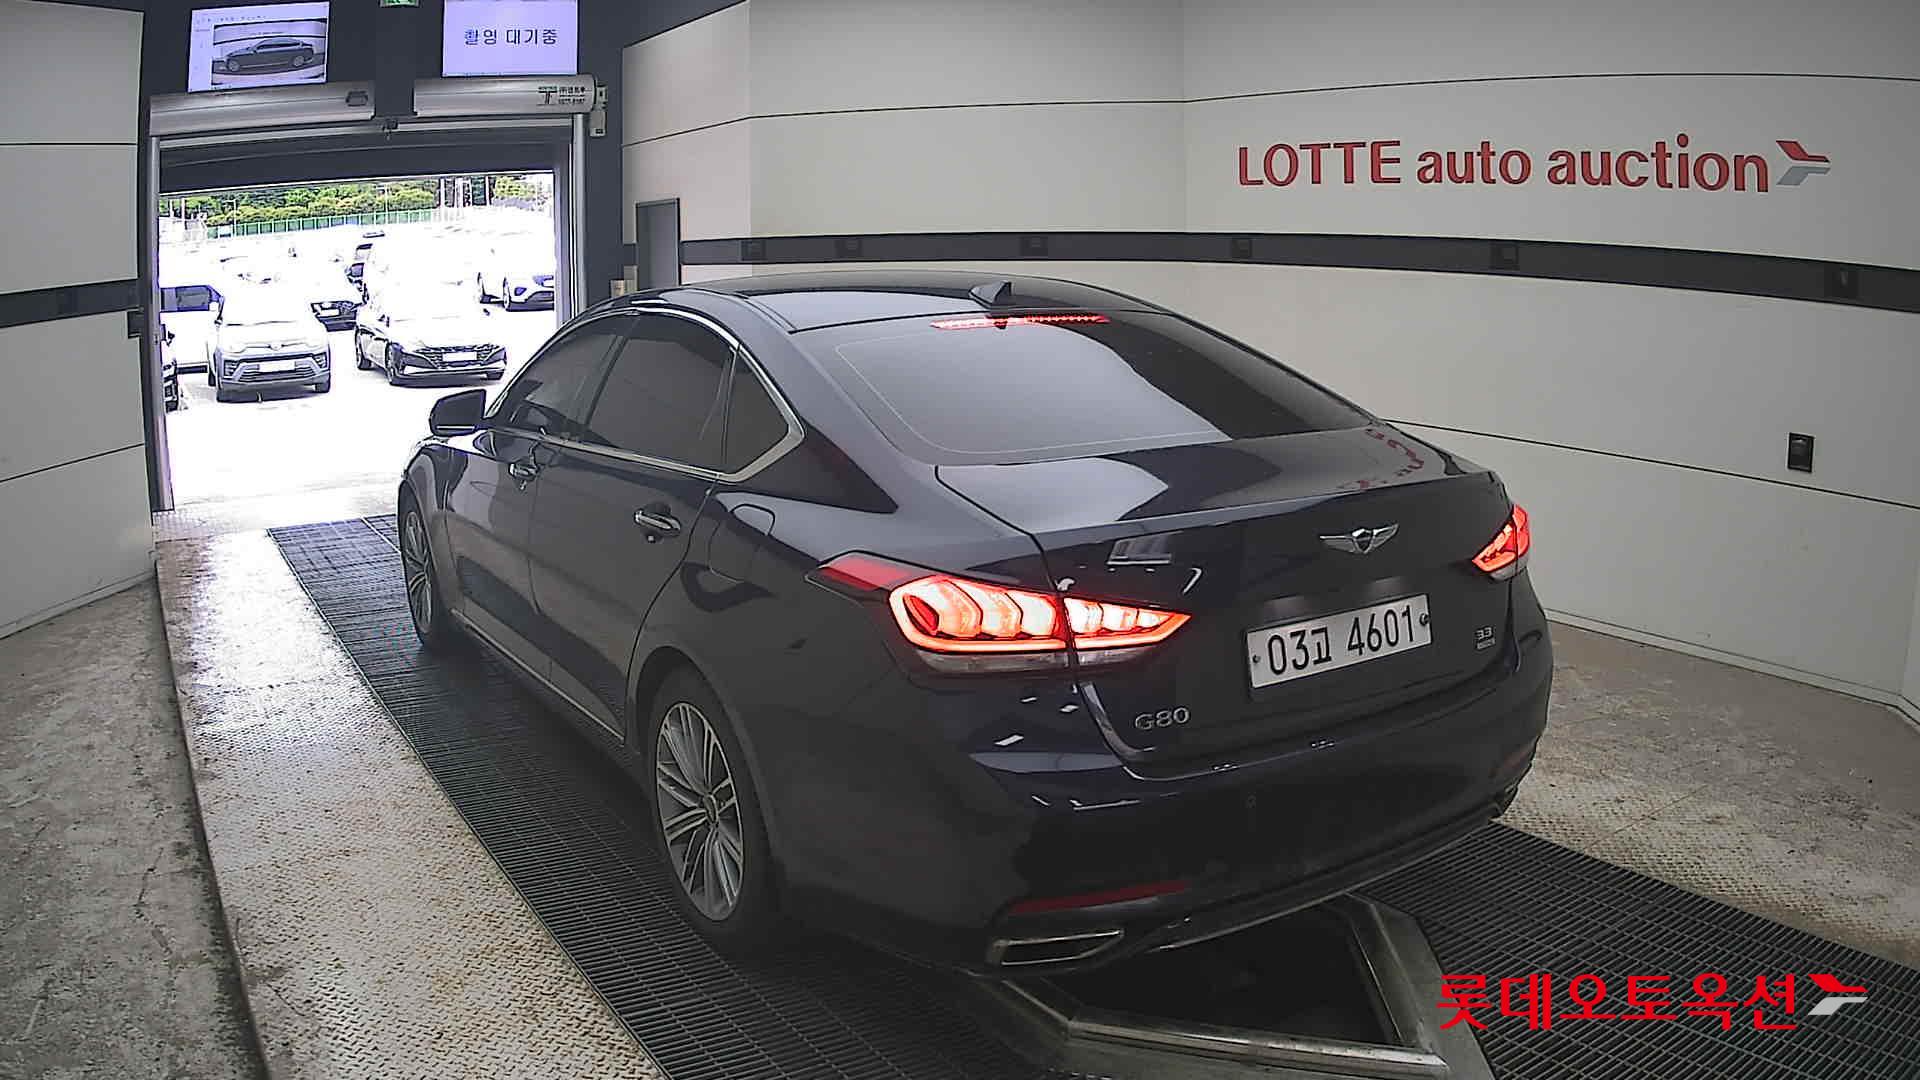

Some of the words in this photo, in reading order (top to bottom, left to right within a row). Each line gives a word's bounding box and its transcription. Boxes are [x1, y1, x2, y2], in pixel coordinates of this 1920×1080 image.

[505, 28, 558, 45] 대기중
[1238, 139, 1401, 187] LOTTE
[1416, 141, 1532, 185] auto
[1547, 133, 1769, 192] auction
[1267, 626, 1332, 676] 03고
[1347, 604, 1414, 656] 4601
[1135, 707, 1190, 730] G80
